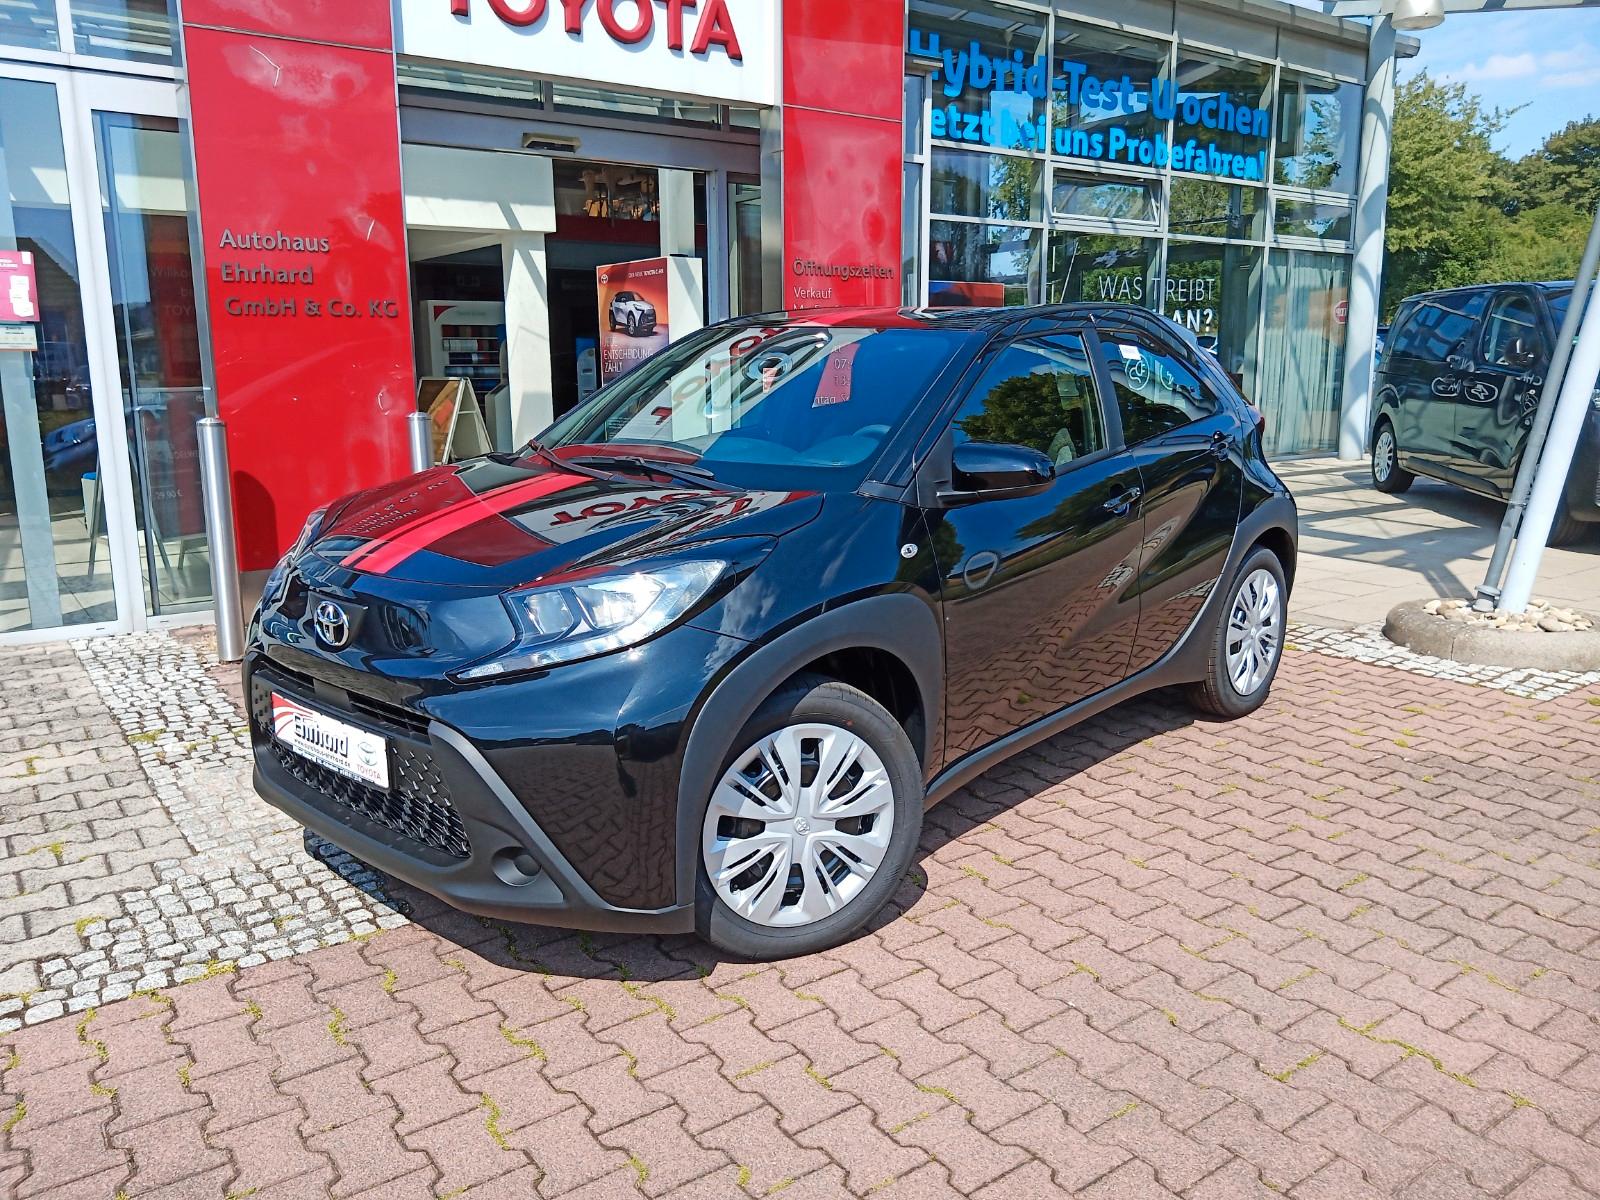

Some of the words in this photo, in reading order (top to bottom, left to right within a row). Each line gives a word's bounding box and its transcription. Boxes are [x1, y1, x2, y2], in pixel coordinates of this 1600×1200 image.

[931, 102, 994, 145] etzt
[1055, 127, 1103, 158] uns
[1109, 127, 1265, 181] Probefahren!
[220, 229, 330, 252] Autohaus
[221, 263, 314, 284] Ehrhard
[793, 258, 894, 281] Öffnungszeiten
[793, 286, 832, 299] Verkauf
[1099, 276, 1143, 300] WAS
[1151, 277, 1215, 301] TREIBT
[225, 298, 297, 317] GmbH
[304, 301, 322, 316] &
[327, 300, 362, 317] Co.
[369, 300, 399, 317] KG
[356, 763, 382, 781] TOYOTA
